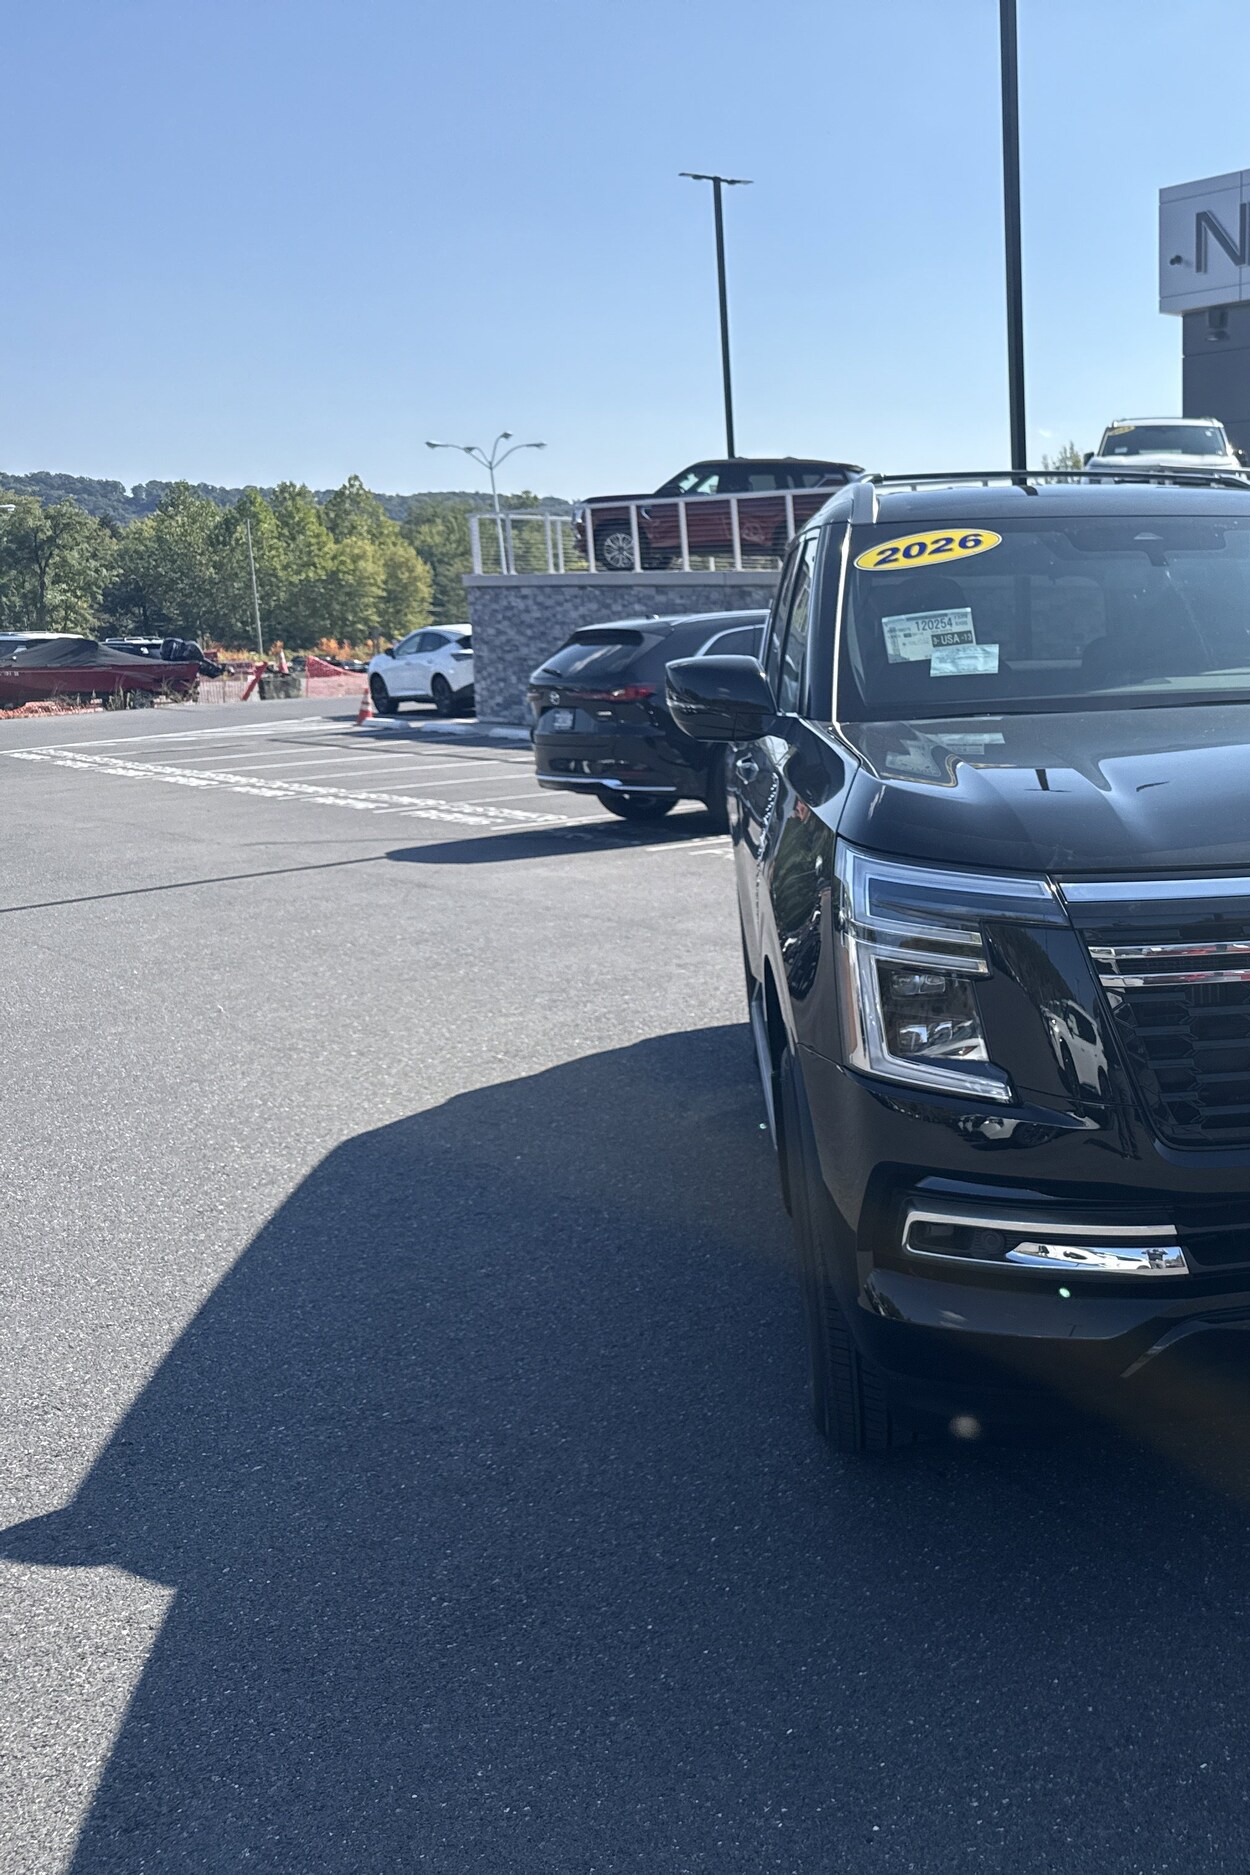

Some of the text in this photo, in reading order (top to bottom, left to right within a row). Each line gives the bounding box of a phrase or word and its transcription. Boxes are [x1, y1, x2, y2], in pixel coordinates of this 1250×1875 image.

[873, 533, 983, 567] 2026
[915, 617, 953, 632] 120254
[941, 633, 960, 645] USA
